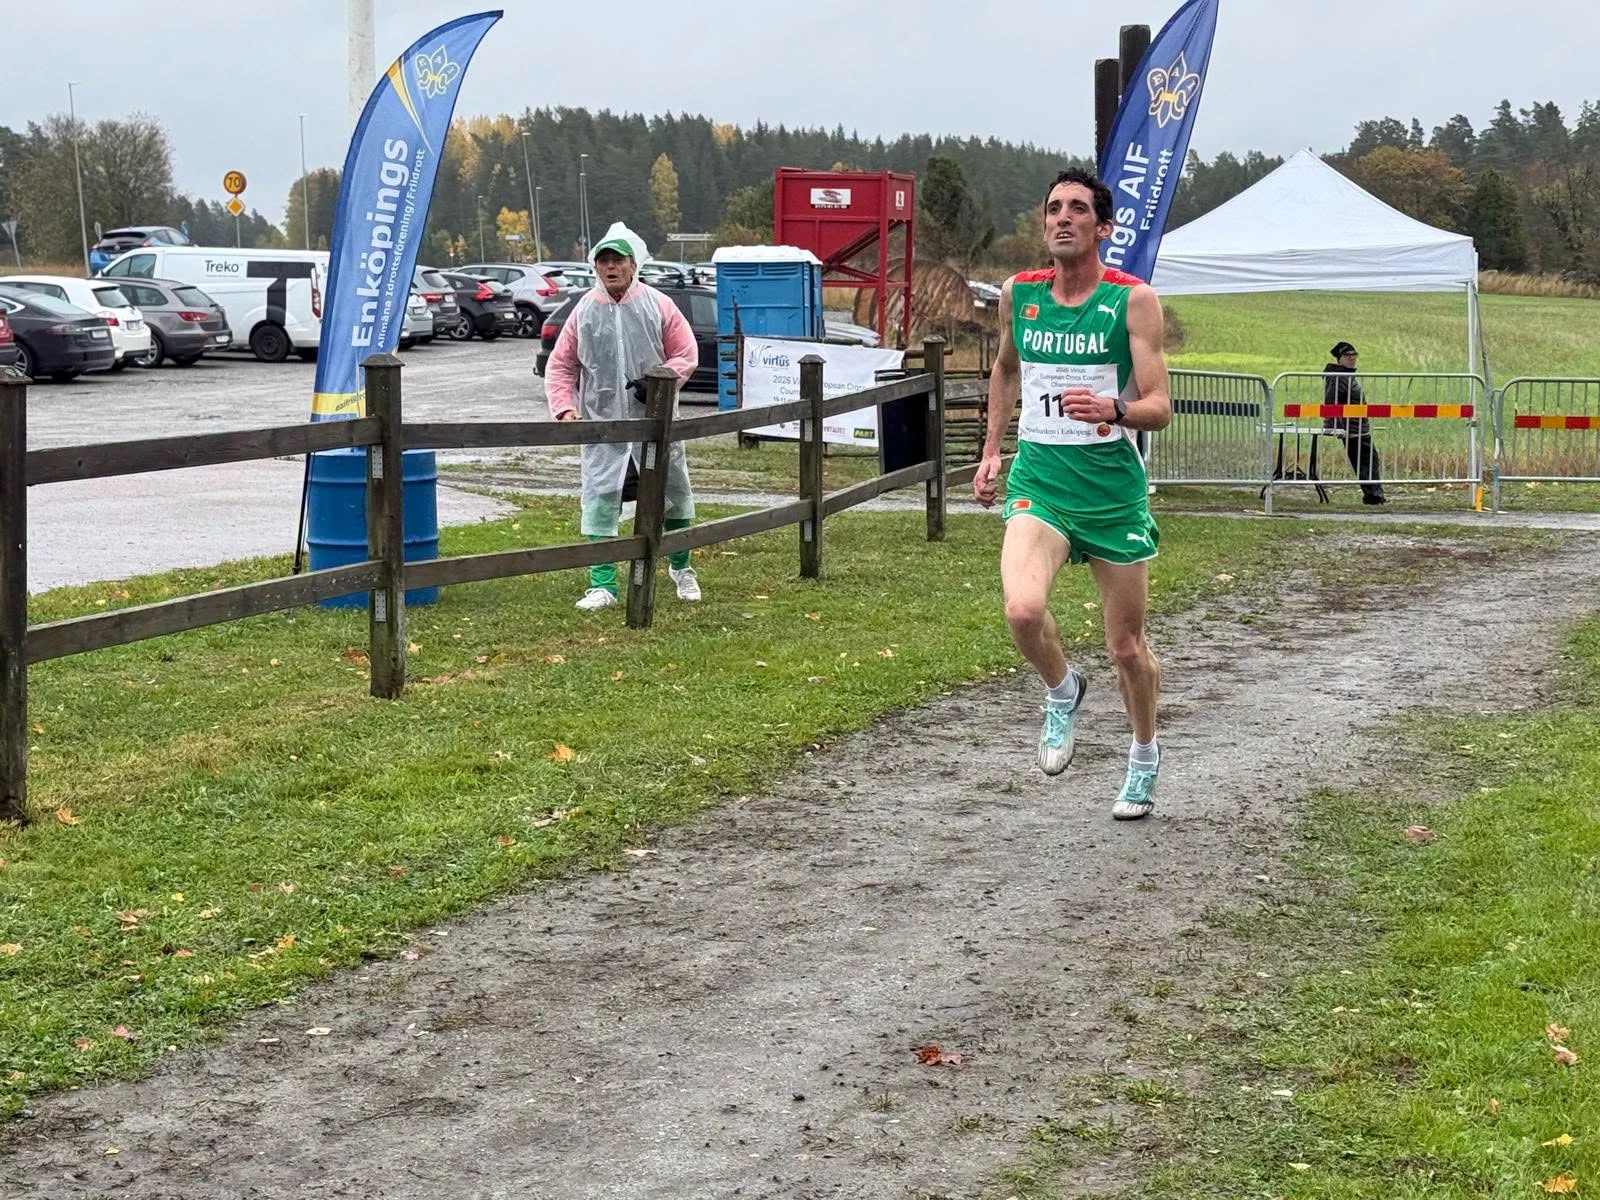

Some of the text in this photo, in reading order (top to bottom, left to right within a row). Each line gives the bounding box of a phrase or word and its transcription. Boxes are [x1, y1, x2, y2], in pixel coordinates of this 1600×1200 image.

[227, 176, 241, 189] 70
[1118, 141, 1149, 200] AIF
[1140, 148, 1174, 230] Friidrott
[351, 138, 410, 347] Enköpings
[205, 260, 240, 273] Treko
[1022, 328, 1109, 355] PORTUGAL
[772, 374, 792, 385] 2026
[1039, 393, 1065, 418] 11
